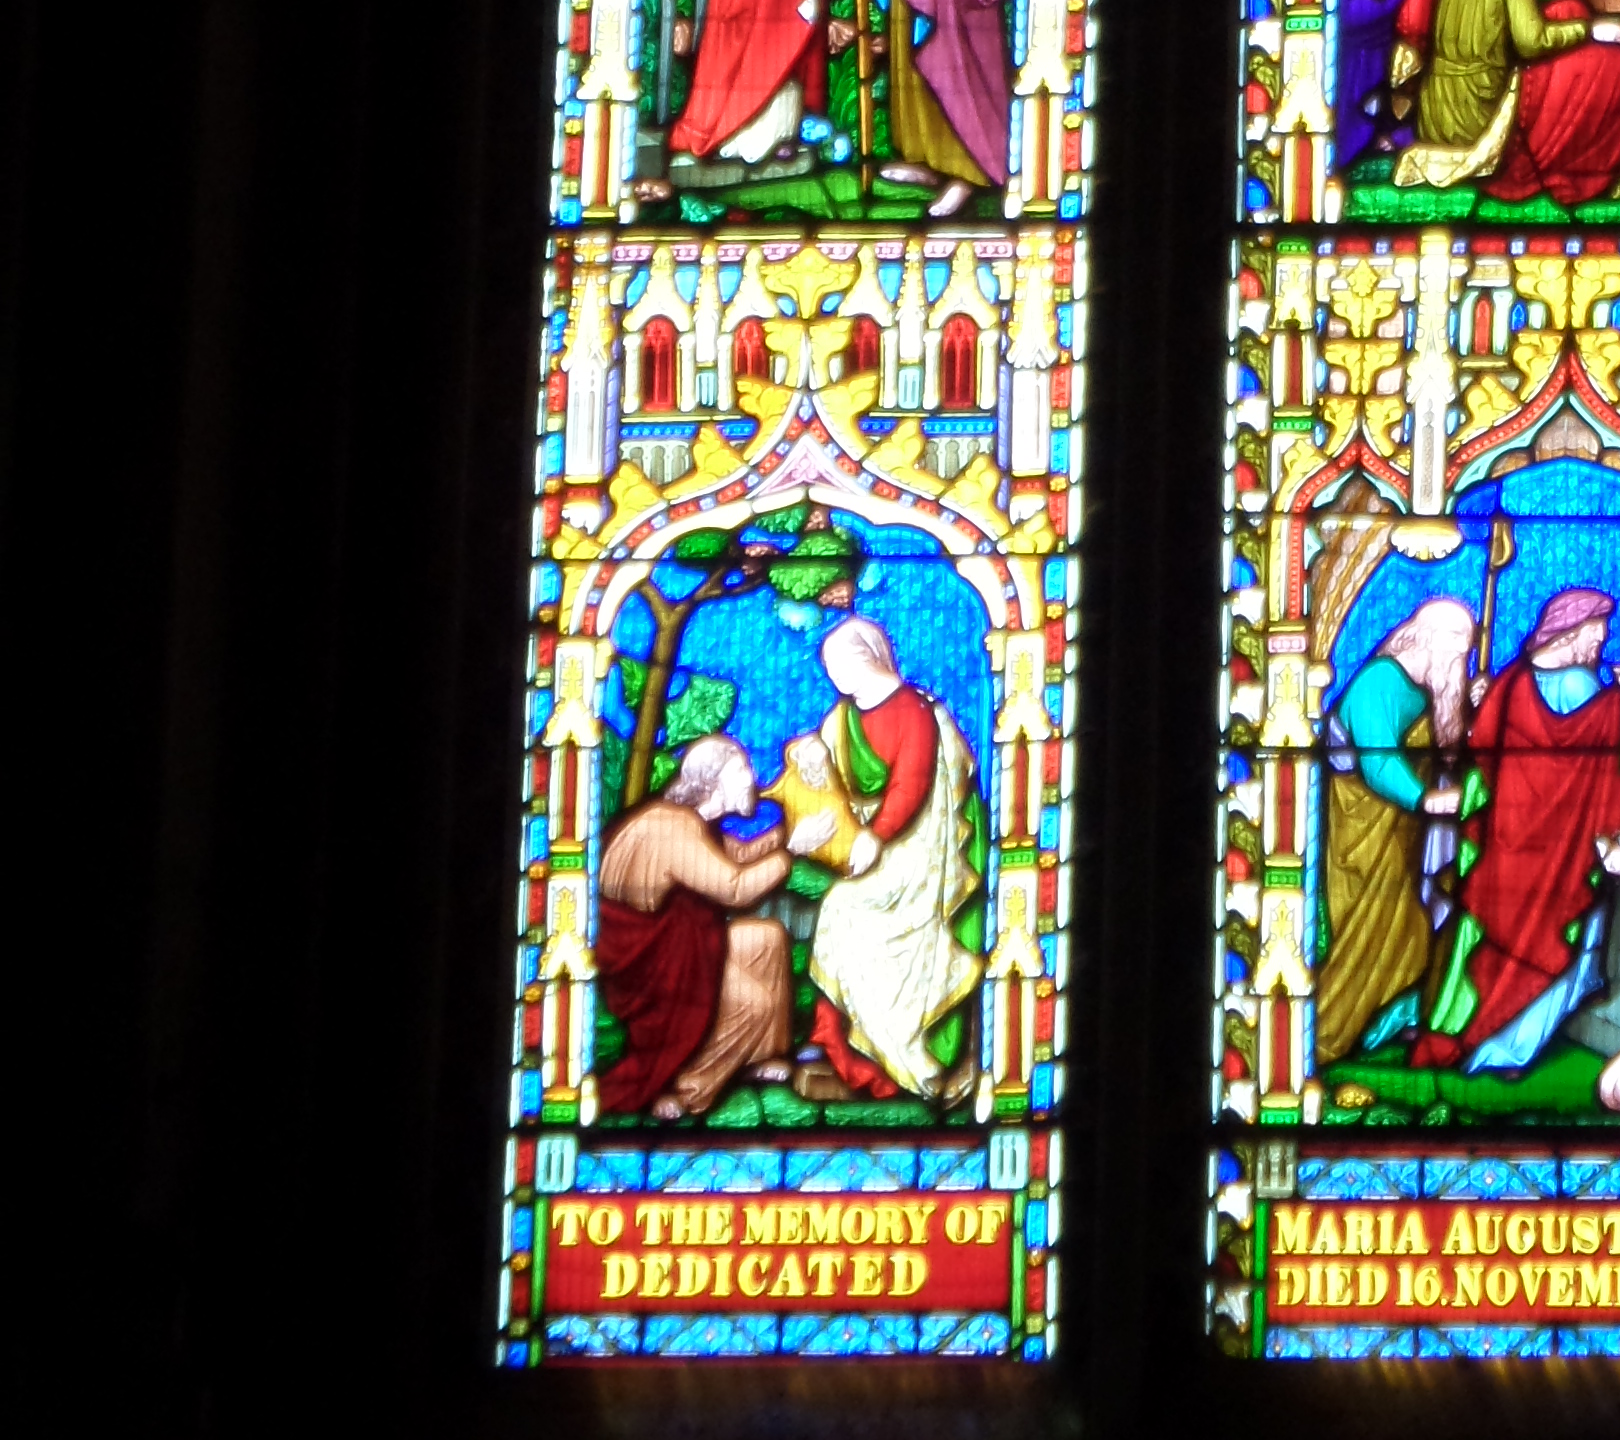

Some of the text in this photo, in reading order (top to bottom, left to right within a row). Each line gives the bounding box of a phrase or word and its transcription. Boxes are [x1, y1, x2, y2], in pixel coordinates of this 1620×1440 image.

[552, 1199, 1006, 1247] TO THE MEMORY OF
[1271, 1205, 1430, 1256] MARIA
[600, 1249, 928, 1300] DEDICATED
[1275, 1259, 1388, 1308] DIED
